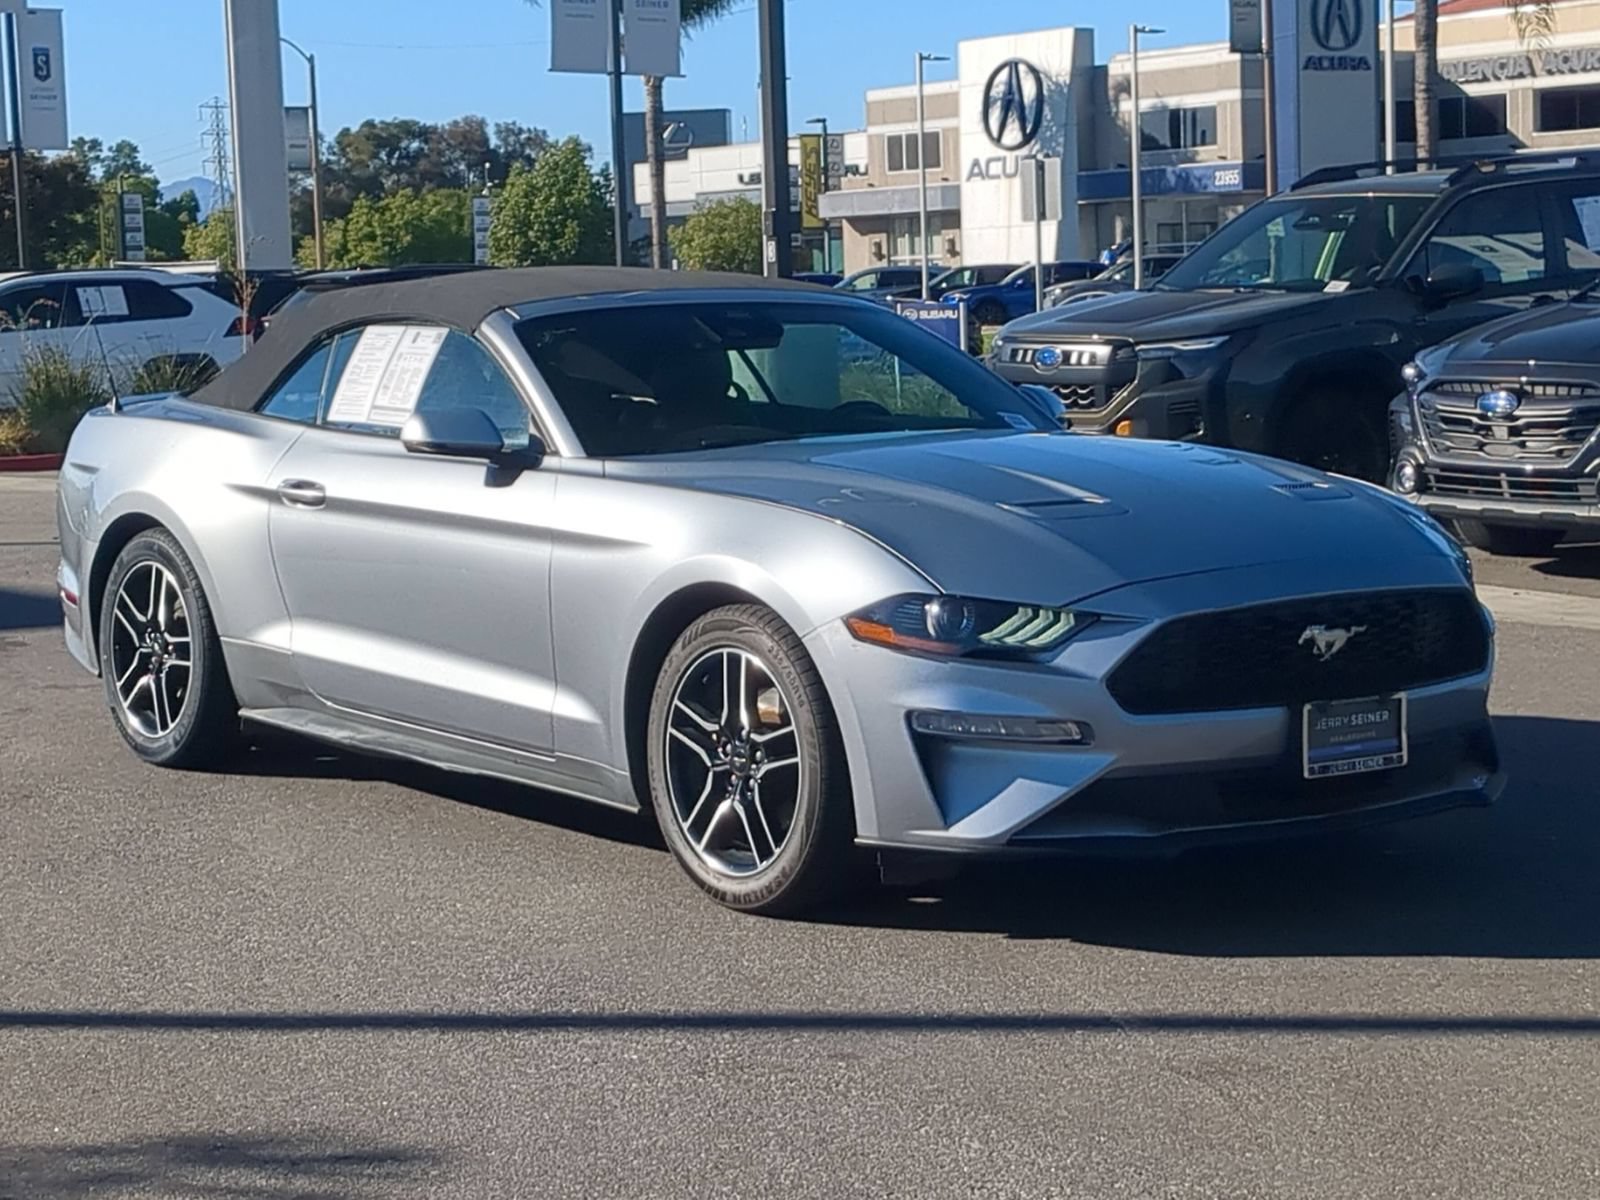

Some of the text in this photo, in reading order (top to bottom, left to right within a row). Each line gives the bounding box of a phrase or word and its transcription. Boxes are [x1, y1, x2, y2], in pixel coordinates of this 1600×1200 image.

[1302, 55, 1372, 71] ACURA
[1440, 48, 1600, 83] ALENCIA ACUR
[965, 155, 1036, 182] ACU
[919, 309, 958, 319] SUBARU
[1315, 710, 1389, 730] JERRY SEINER
